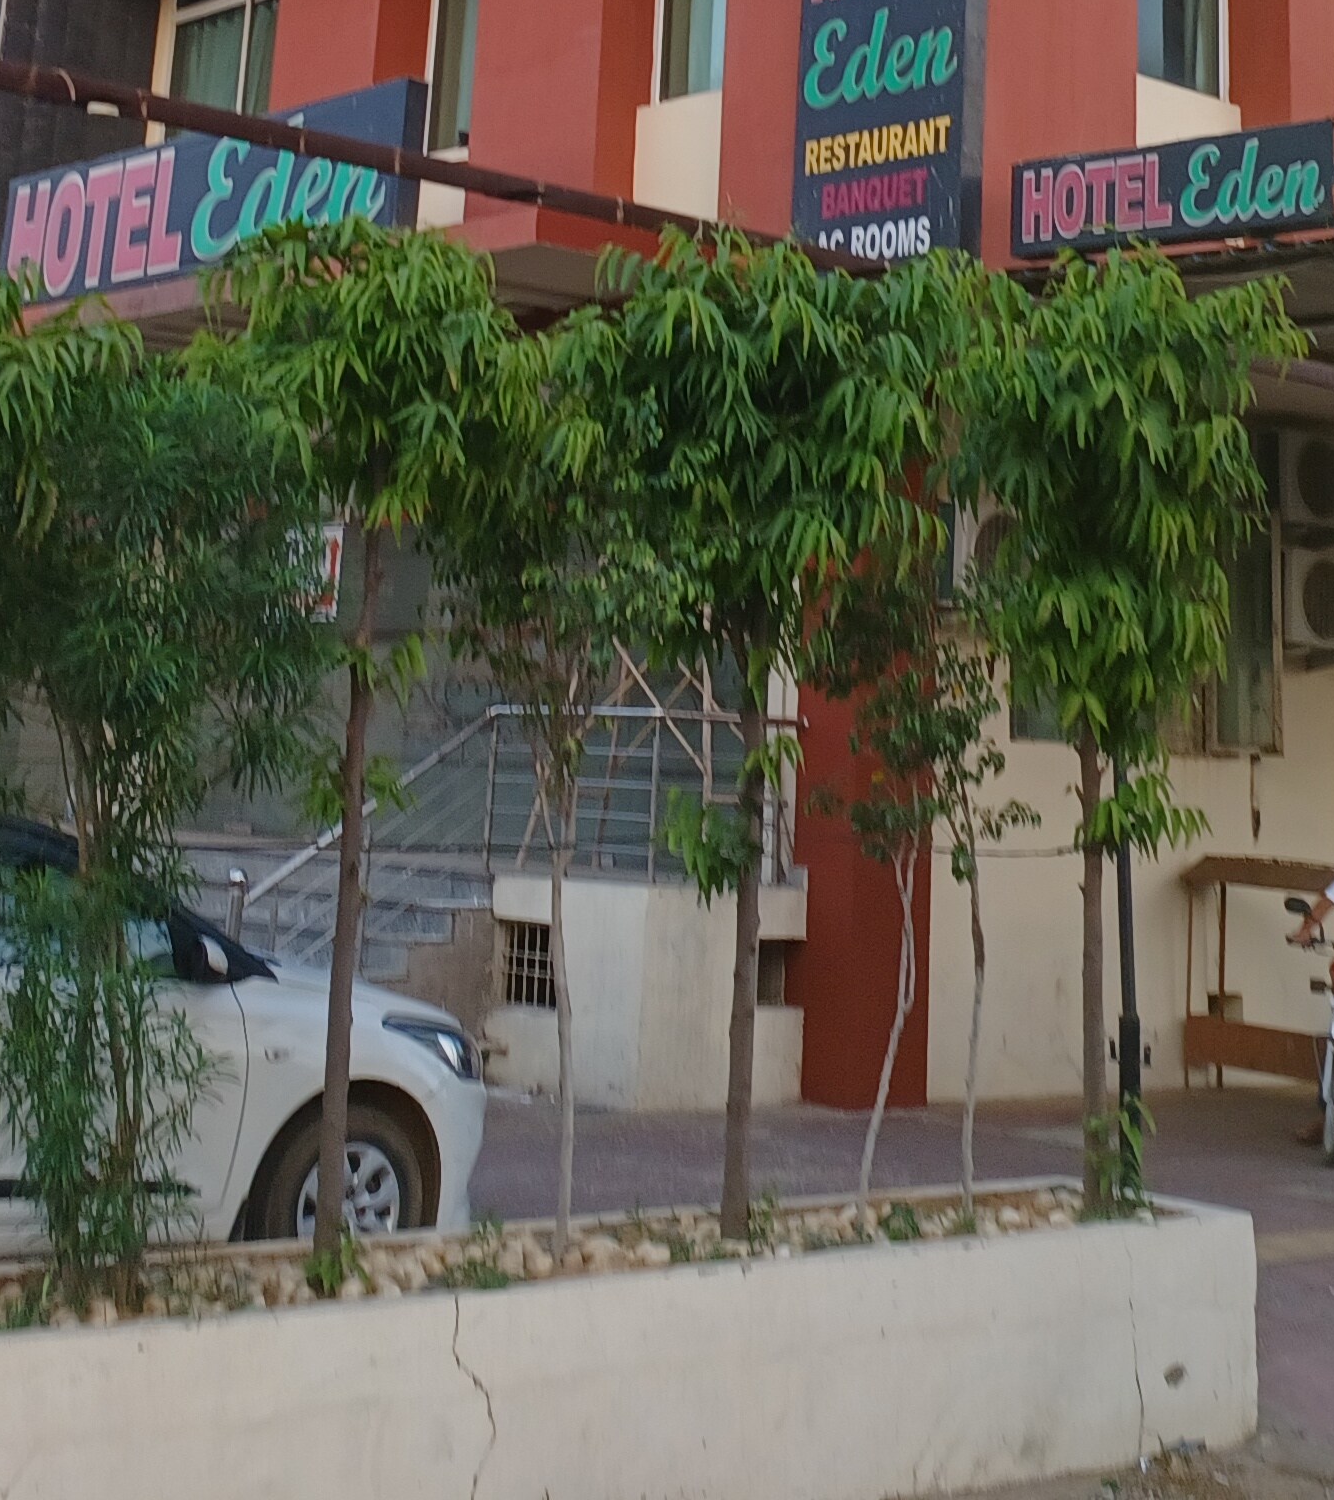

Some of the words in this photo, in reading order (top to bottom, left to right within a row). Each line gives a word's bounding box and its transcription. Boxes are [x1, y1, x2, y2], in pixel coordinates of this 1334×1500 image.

[803, 6, 958, 110] Eden
[804, 114, 952, 178] RESTAURANT
[7, 146, 182, 300] HOTEL
[190, 113, 386, 263] Eden
[820, 167, 929, 221] BANQUET
[1021, 152, 1173, 245] HOTEL
[1179, 136, 1326, 228] Eden
[850, 214, 932, 261] ROOMS
